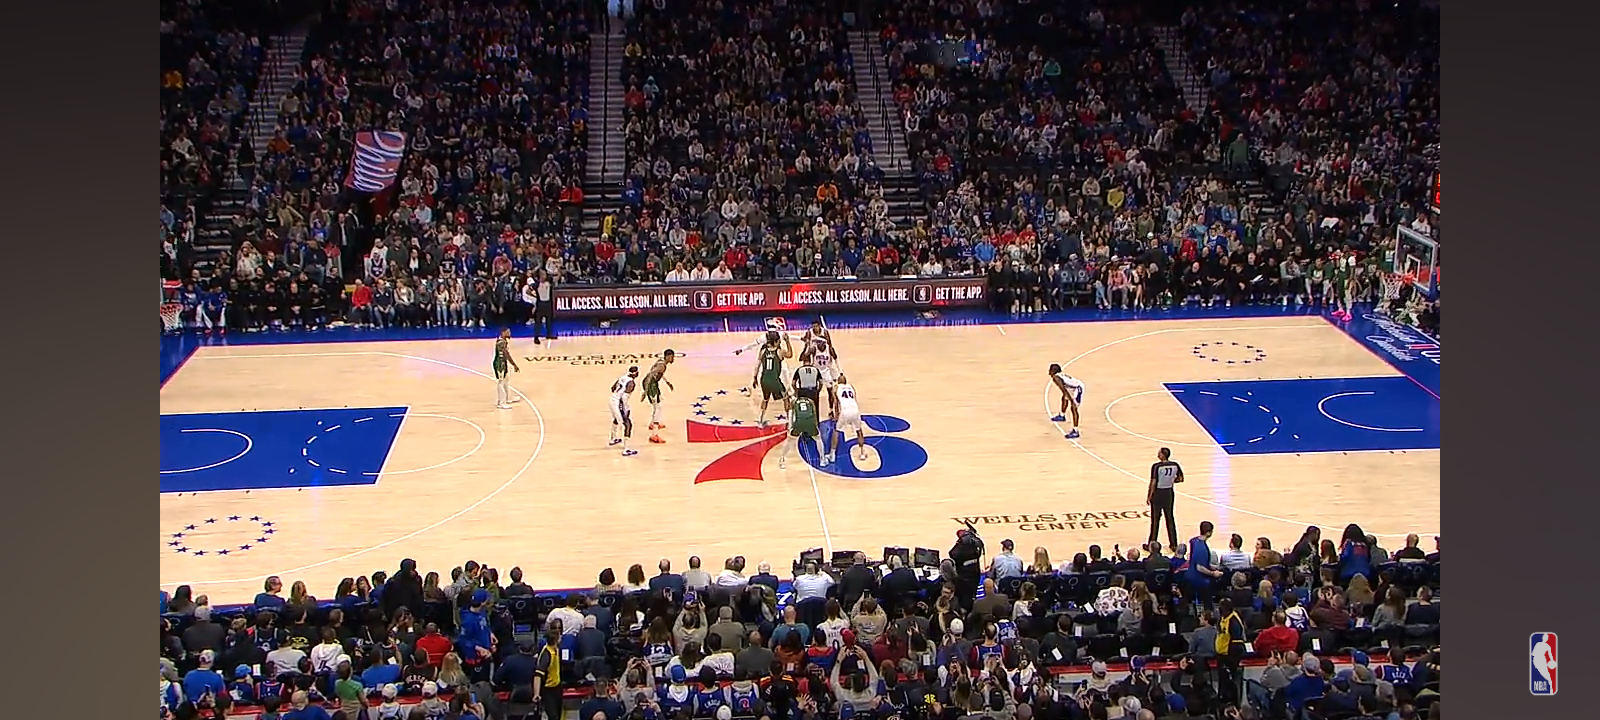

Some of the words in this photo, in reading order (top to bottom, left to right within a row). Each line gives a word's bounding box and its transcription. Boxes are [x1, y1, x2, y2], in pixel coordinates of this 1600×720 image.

[778, 291, 793, 305] ALL
[793, 290, 825, 305] ACCESS.
[825, 289, 839, 304] ALL
[839, 288, 872, 303] SEASON.
[873, 288, 887, 302] ALL
[887, 287, 909, 302] HERE.
[935, 287, 950, 300] GET
[950, 286, 966, 300] THE
[966, 285, 983, 299] APP.
[556, 297, 571, 311] ALL
[571, 295, 603, 311] ACCESS.
[604, 294, 619, 309] ALL
[619, 293, 652, 309] SEASON.
[653, 293, 668, 308] ALL
[668, 292, 690, 308] HERE.
[716, 293, 732, 306] GET
[732, 292, 748, 306] THE
[748, 291, 766, 306] APP.
[523, 354, 604, 362] WELLS
[766, 358, 773, 370] 11
[841, 390, 854, 399] 40
[800, 402, 807, 410] 6
[686, 414, 929, 484] 76
[1165, 467, 1172, 476] 77
[951, 514, 1056, 525] WELLS
[1019, 521, 1110, 531] CENTER
